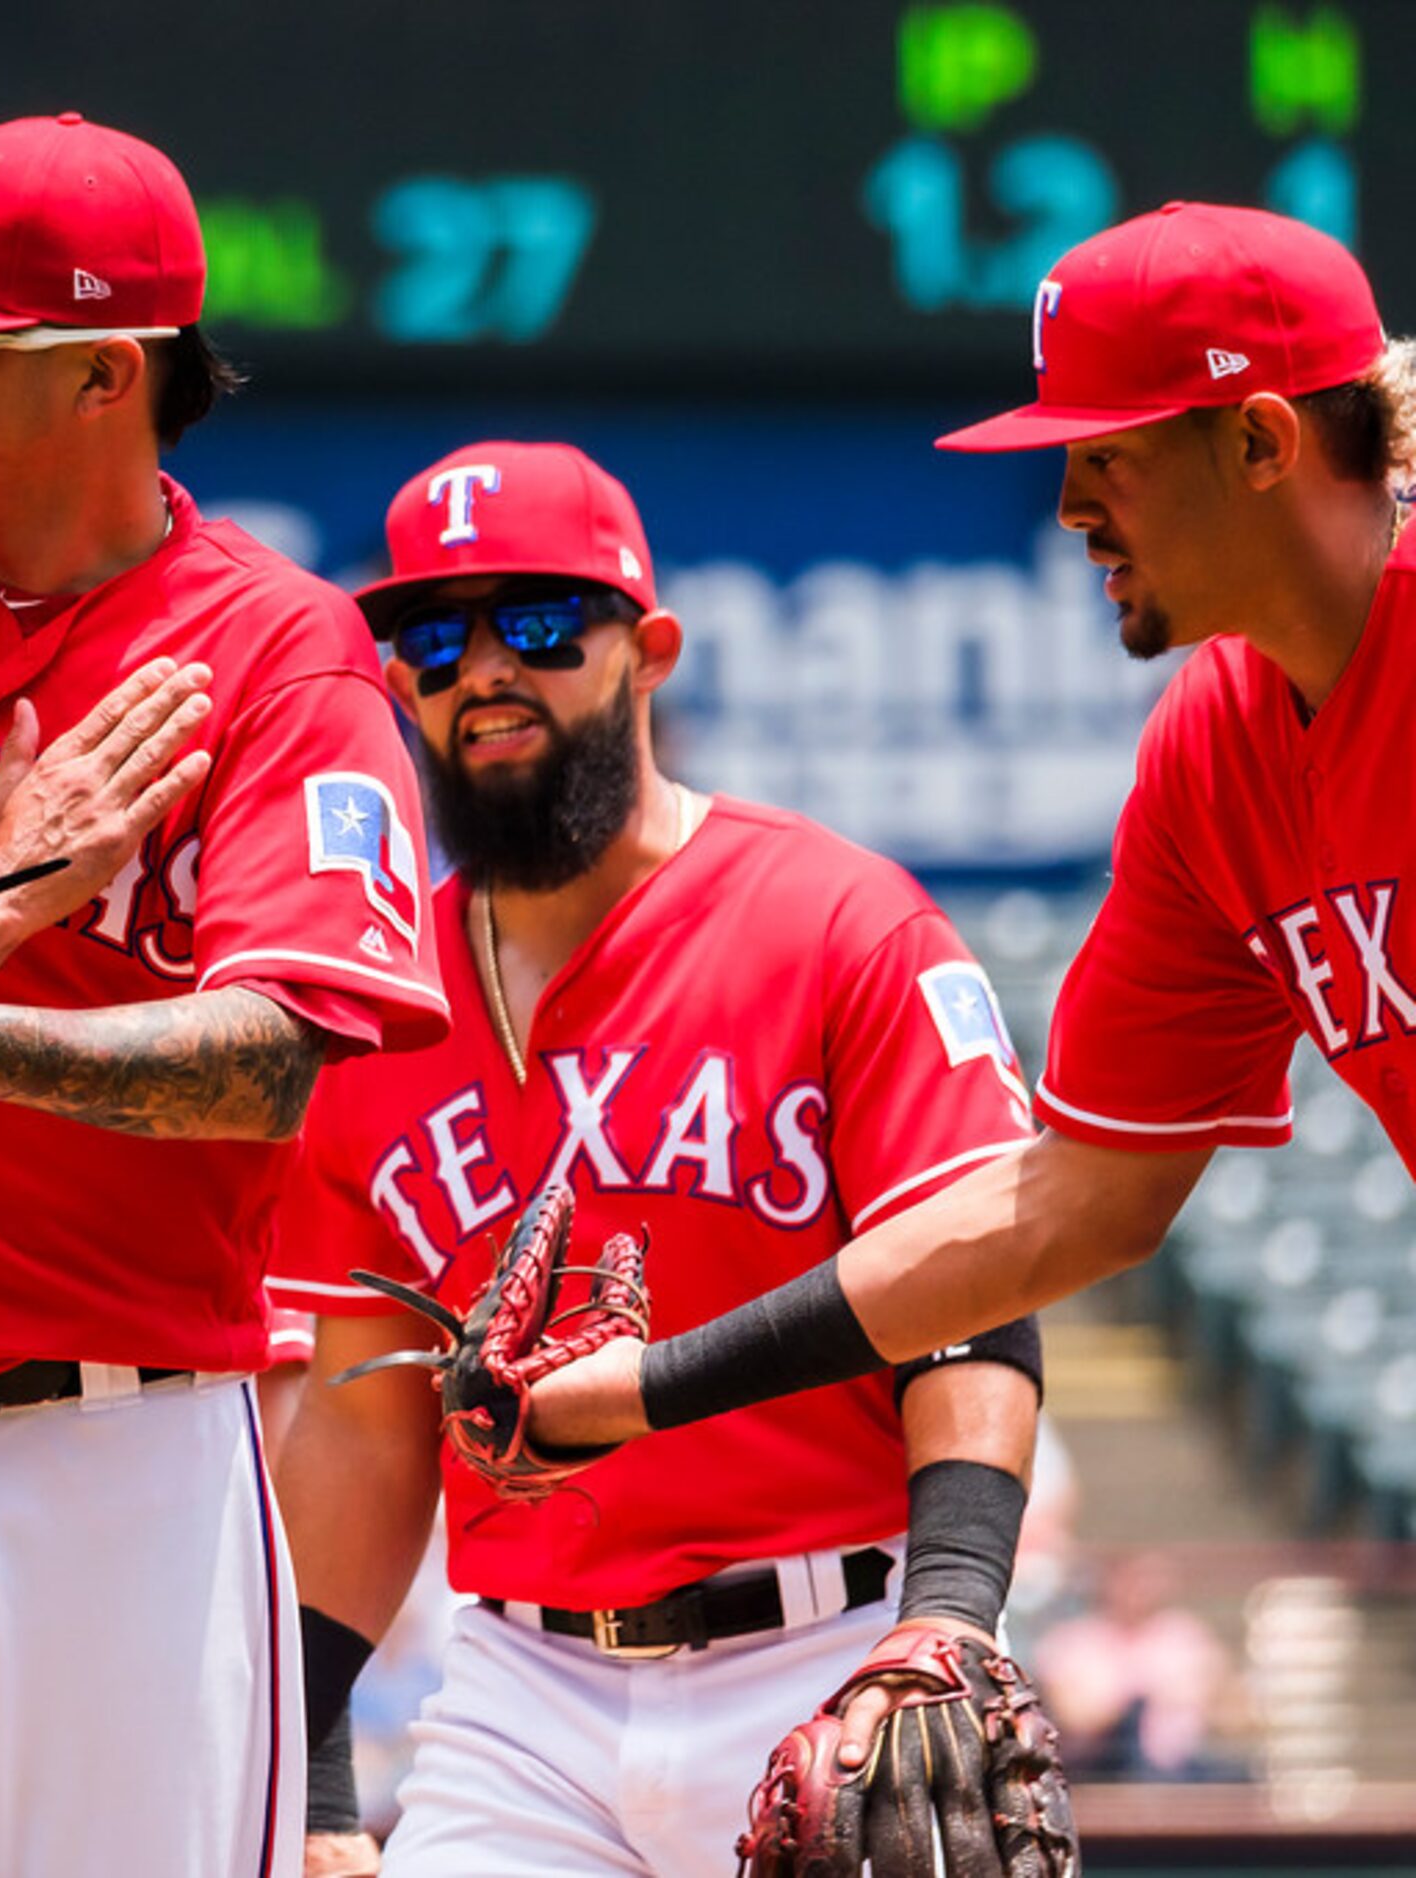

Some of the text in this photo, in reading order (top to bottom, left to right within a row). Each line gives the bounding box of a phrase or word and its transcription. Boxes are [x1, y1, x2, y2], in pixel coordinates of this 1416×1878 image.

[374, 175, 596, 344] 27
[427, 464, 502, 548] T
[370, 1043, 834, 1288] TEXAS
